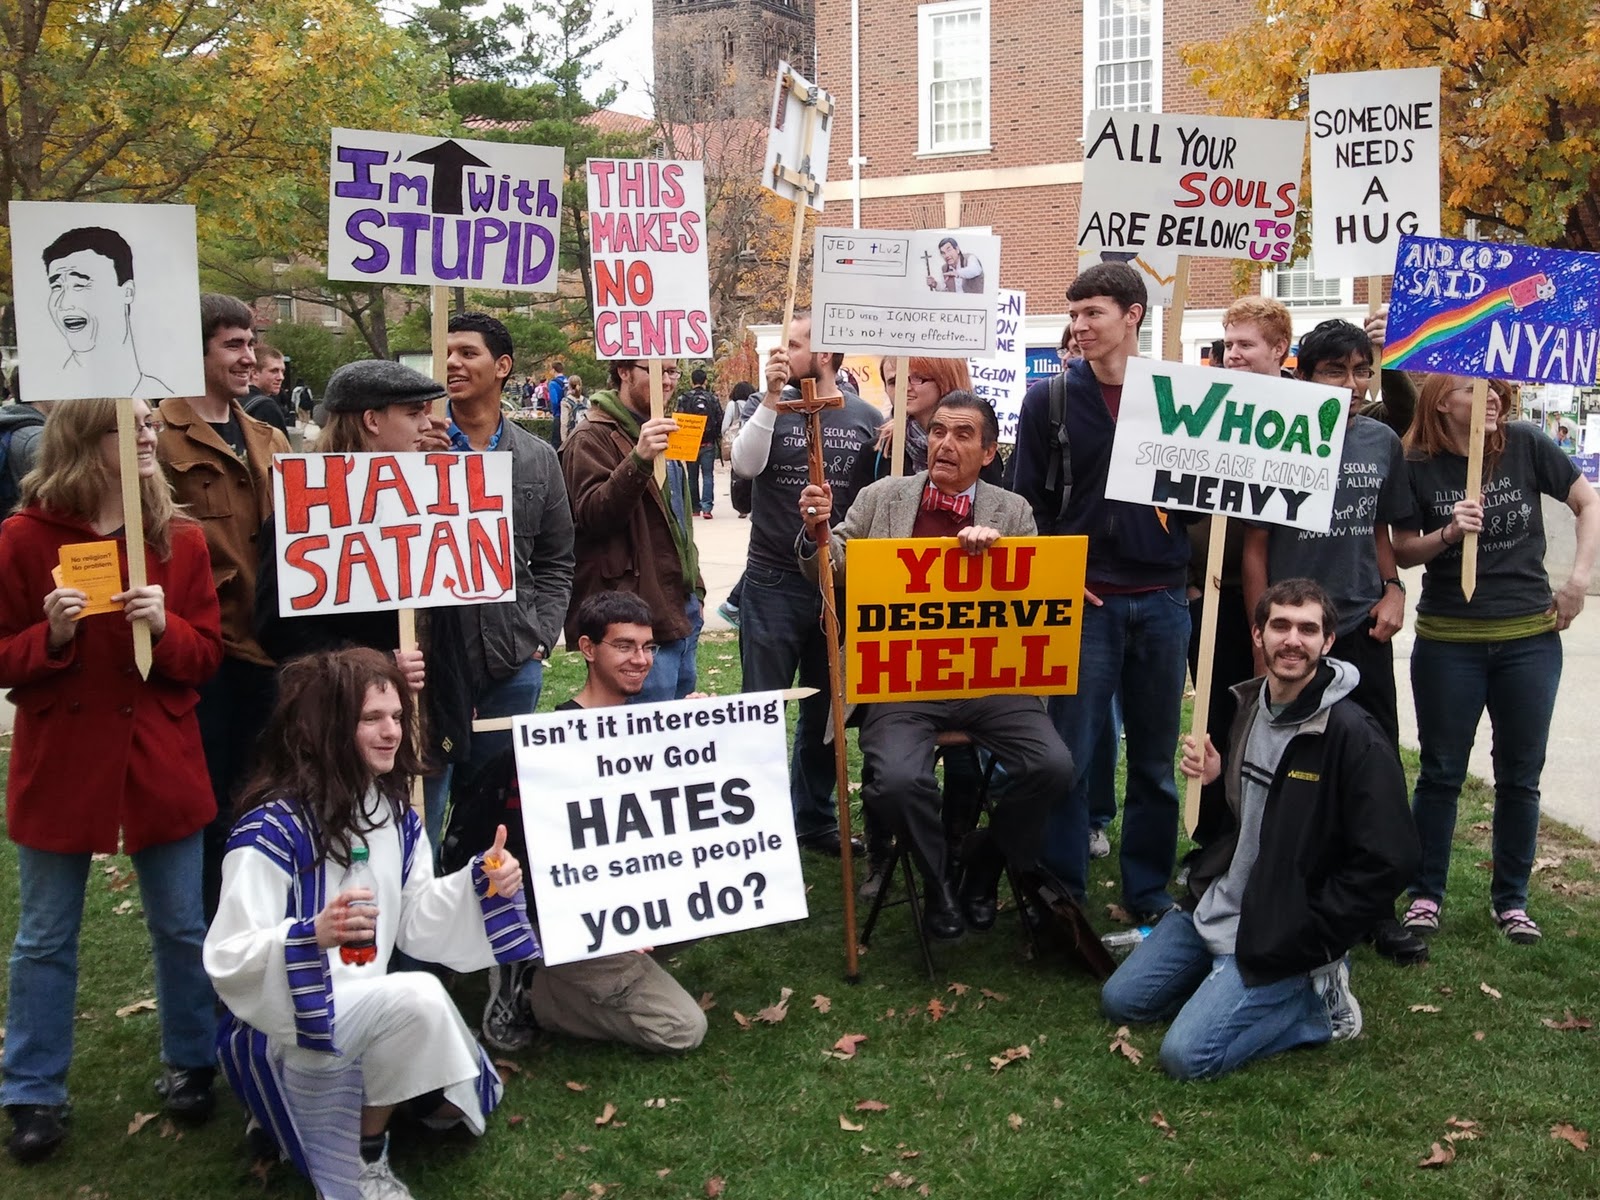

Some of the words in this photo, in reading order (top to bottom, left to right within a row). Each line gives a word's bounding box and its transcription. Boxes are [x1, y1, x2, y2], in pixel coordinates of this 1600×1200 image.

[1314, 102, 1433, 138] SOMEONE
[1086, 117, 1162, 163] ALL
[1177, 127, 1237, 170] YOUR
[1336, 139, 1415, 168] NEEDS
[335, 145, 428, 206] I'm
[589, 161, 686, 208] THIS
[1174, 172, 1297, 218] SOULS
[1362, 176, 1389, 205] A
[345, 208, 555, 285] STUPID
[590, 211, 701, 254] MAKES
[827, 240, 855, 251] JED
[1078, 211, 1151, 247] ARE
[1156, 213, 1250, 251] BELONG
[1254, 219, 1292, 239] TO
[1336, 211, 1419, 244] HUG
[1249, 241, 1290, 262] US
[1403, 243, 1454, 269] AND
[1459, 246, 1514, 270] GOD
[594, 260, 654, 307] NO
[1407, 269, 1487, 299] SAID
[596, 310, 709, 356] CENTS
[828, 308, 855, 319] JED
[886, 310, 936, 322] IGNORE
[940, 313, 985, 325] REALITY
[828, 326, 854, 337] It's
[861, 328, 884, 338] not
[890, 332, 916, 342] very
[971, 364, 1017, 383] IGION
[1484, 320, 1597, 385] NYAN
[823, 427, 857, 439] SECULAR
[1152, 374, 1341, 458] WHOA!
[1136, 441, 1211, 473] SIGNS
[1215, 453, 1257, 480] ARE
[1262, 459, 1329, 491] KINDA
[1343, 462, 1378, 474] SECULAR
[1481, 476, 1512, 494] CULAR
[274, 453, 503, 534] HAIL
[1151, 469, 1312, 521] HEAVY
[1482, 489, 1523, 509] LLIANCE
[82, 552, 112, 563] religion?
[285, 517, 514, 610] SATAN
[897, 546, 1036, 593] YOU
[857, 599, 1072, 632] DESERVE
[856, 635, 1068, 694] HELL
[520, 719, 588, 747] Isn't
[596, 715, 618, 739] it
[627, 699, 779, 736] interesting
[597, 751, 654, 777] how
[664, 741, 717, 768] God
[566, 778, 756, 850] HATES
[550, 863, 599, 888] the
[608, 850, 684, 877] same
[692, 831, 782, 868] people
[580, 898, 672, 952] you
[687, 872, 767, 922] do?
